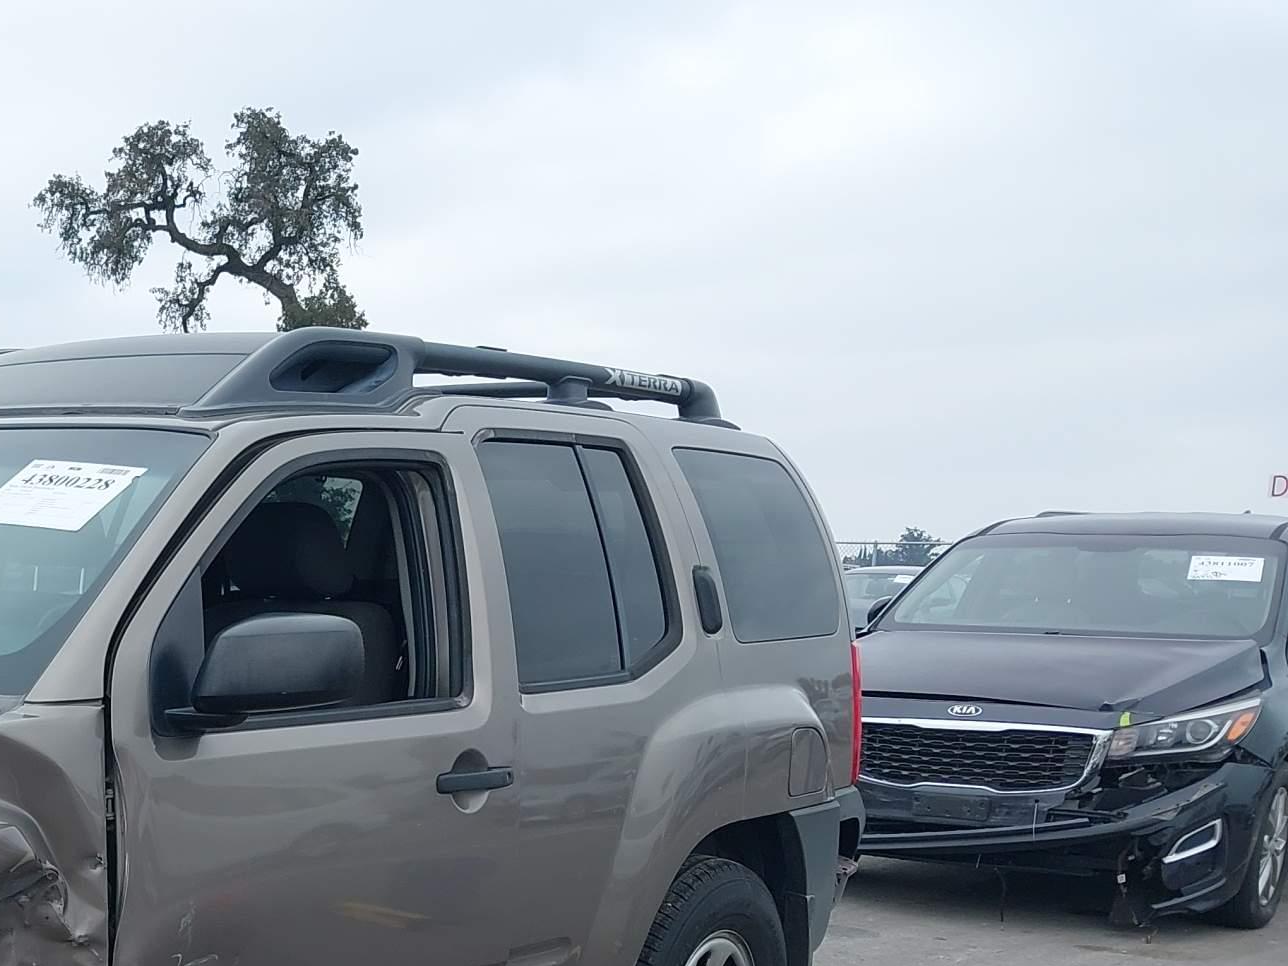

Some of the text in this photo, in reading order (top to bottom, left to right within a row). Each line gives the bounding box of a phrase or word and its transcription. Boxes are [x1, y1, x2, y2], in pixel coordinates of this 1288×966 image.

[604, 367, 680, 394] XTERRA
[21, 473, 116, 491] 43800228
[952, 704, 976, 714] KIA
